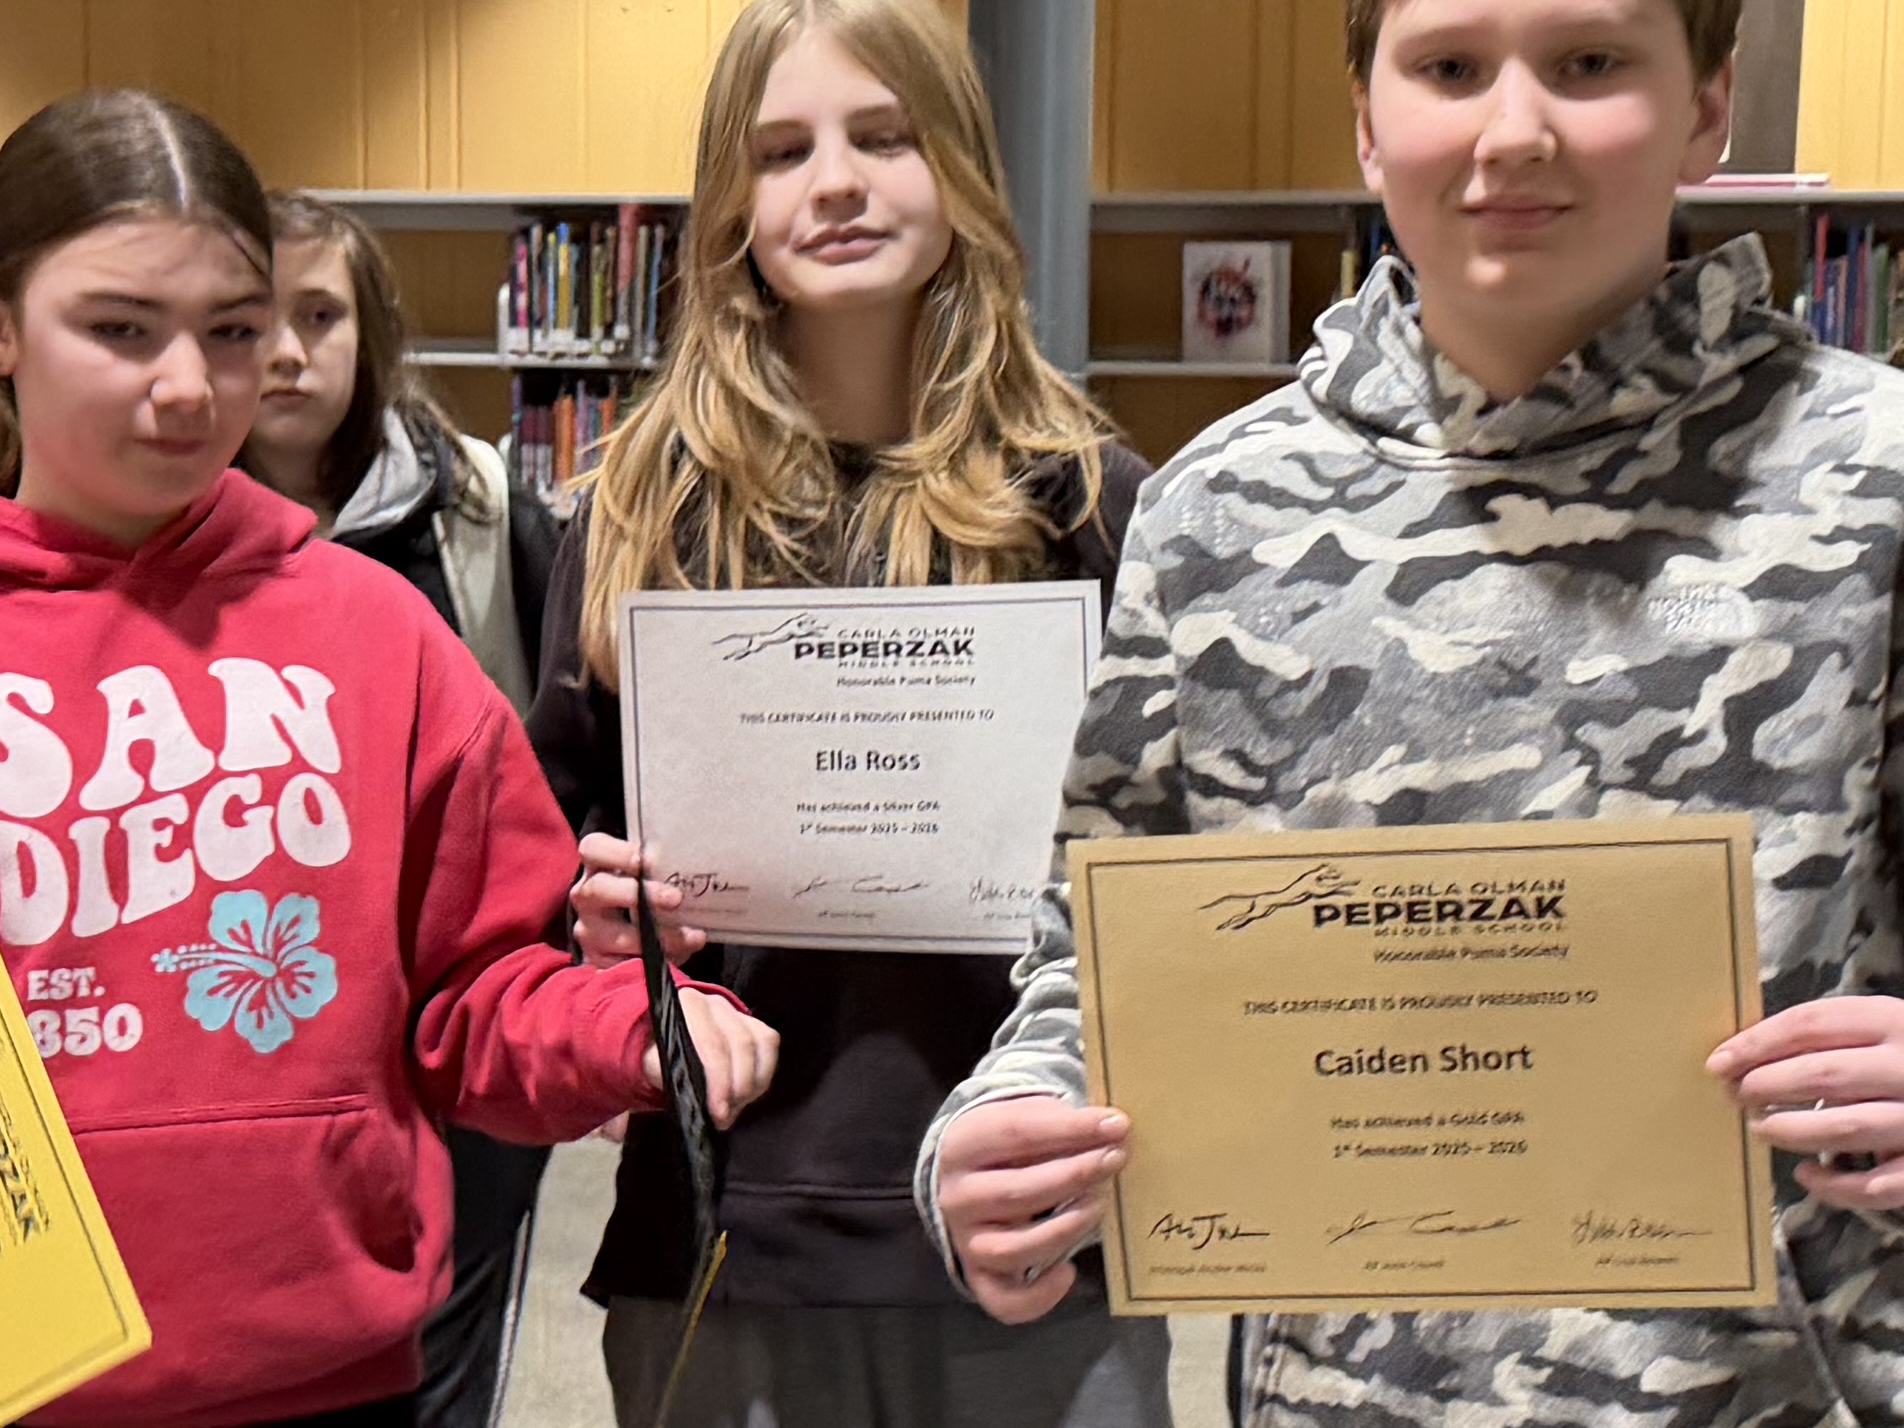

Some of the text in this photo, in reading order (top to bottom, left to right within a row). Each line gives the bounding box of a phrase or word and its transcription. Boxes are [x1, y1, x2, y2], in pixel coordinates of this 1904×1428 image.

[795, 638, 974, 660] PEPERZAK
[815, 749, 921, 772] Ella Ross
[1372, 878, 1566, 898] CARLA OLMAN
[1313, 894, 1565, 929] PEPERZAK
[27, 967, 106, 1001] EST.
[1280, 995, 1377, 1014] CERTIFICATE
[1477, 990, 1571, 1009] PRESENTED
[1575, 989, 1600, 1005] TO
[30, 1002, 143, 1058] 850
[1314, 1042, 1535, 1076] Caiden Short
